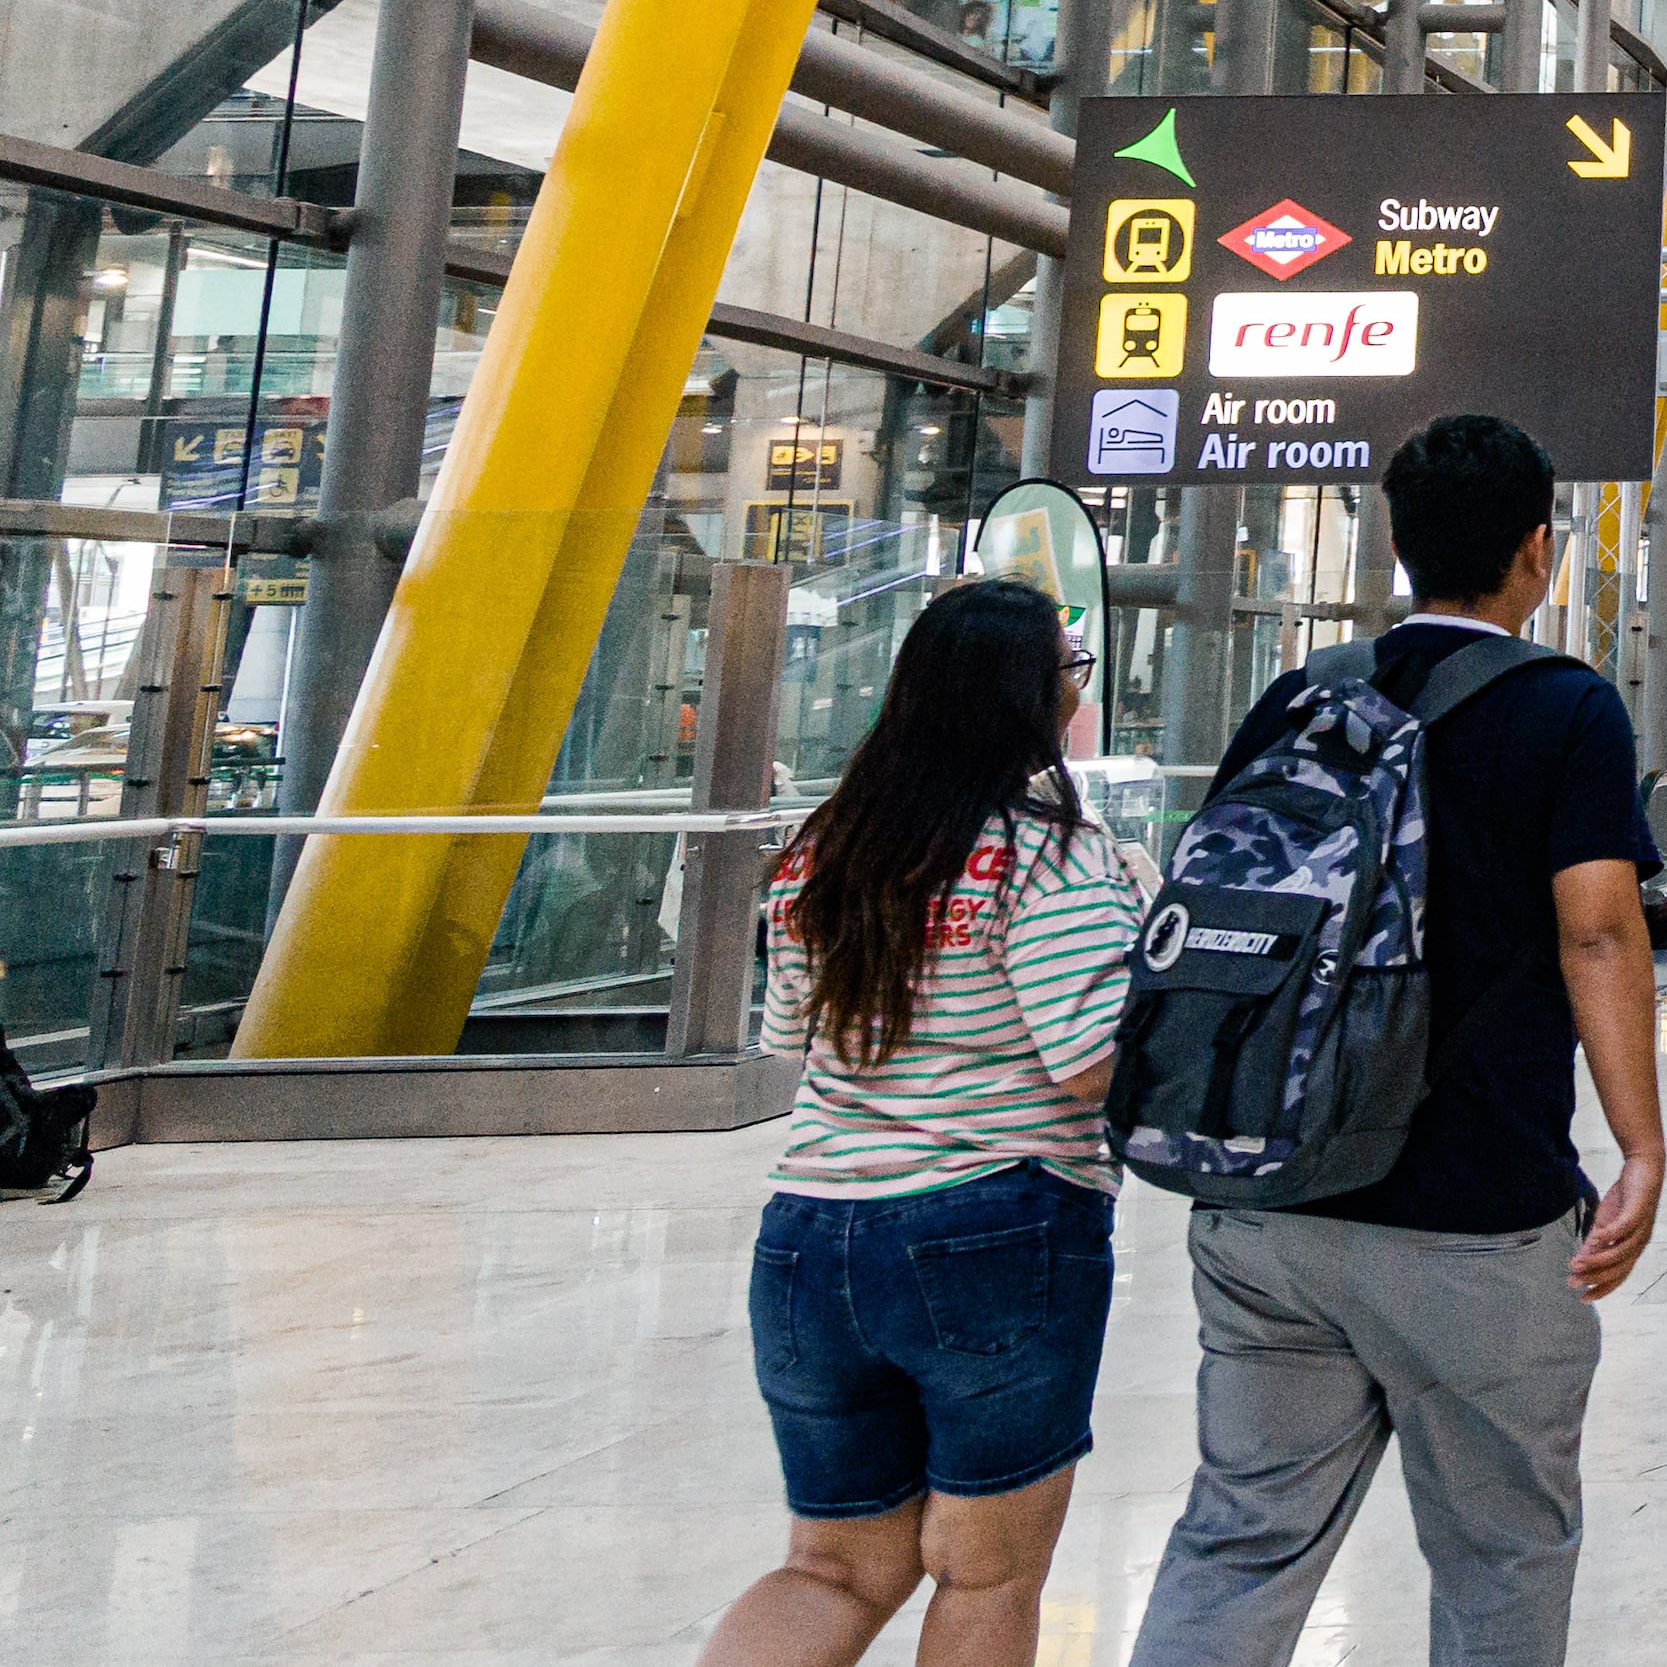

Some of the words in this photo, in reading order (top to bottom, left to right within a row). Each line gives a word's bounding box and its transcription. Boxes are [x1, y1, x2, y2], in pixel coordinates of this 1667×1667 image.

[1378, 198, 1500, 235] Subway
[1256, 230, 1314, 249] Metro
[1374, 240, 1488, 276] Metro
[1233, 303, 1395, 363] renfe
[1201, 391, 1246, 425] Air
[1253, 398, 1337, 426] room
[1197, 433, 1257, 470] Air
[1266, 439, 1370, 470] room
